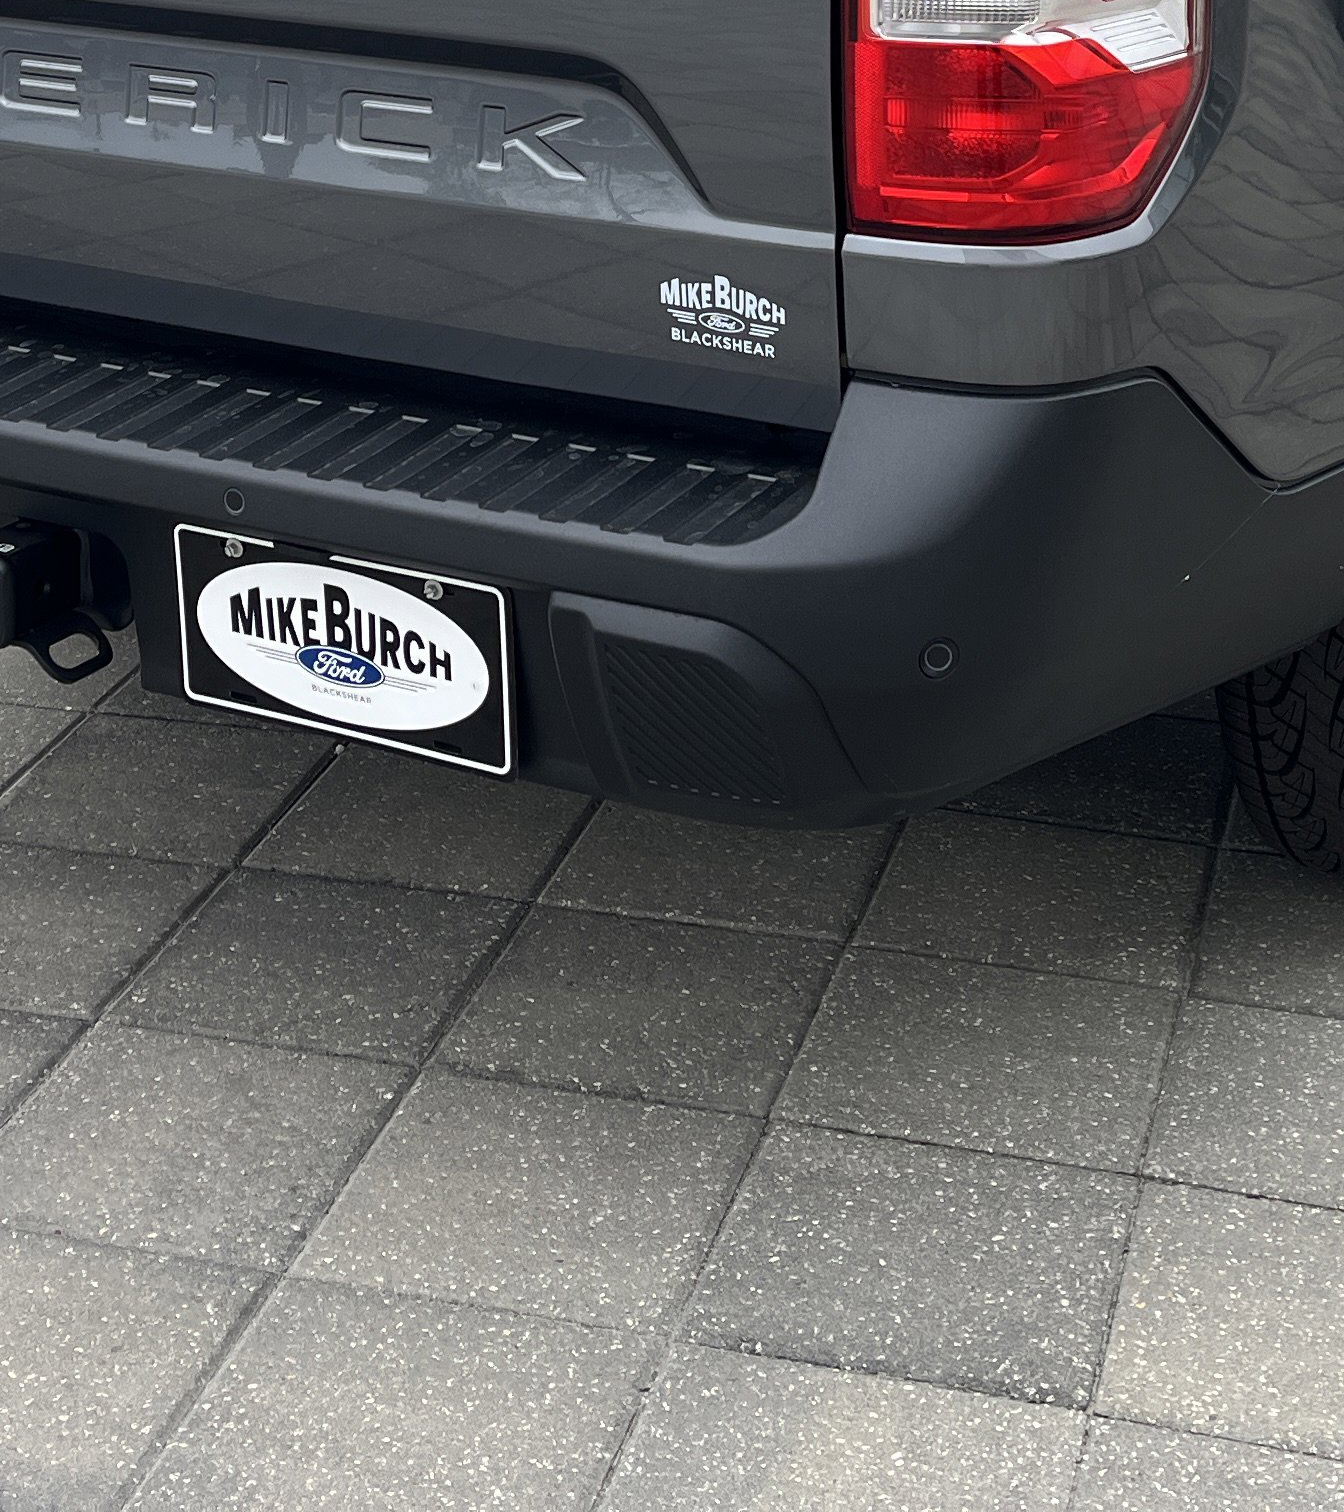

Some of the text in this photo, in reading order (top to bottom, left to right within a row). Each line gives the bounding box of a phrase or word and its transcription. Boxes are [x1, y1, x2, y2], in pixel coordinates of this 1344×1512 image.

[707, 314, 737, 330] Ford
[671, 326, 776, 359] BLACKSHEAR
[312, 650, 369, 685] Ford
[311, 683, 372, 704] BLACKSHEAR
